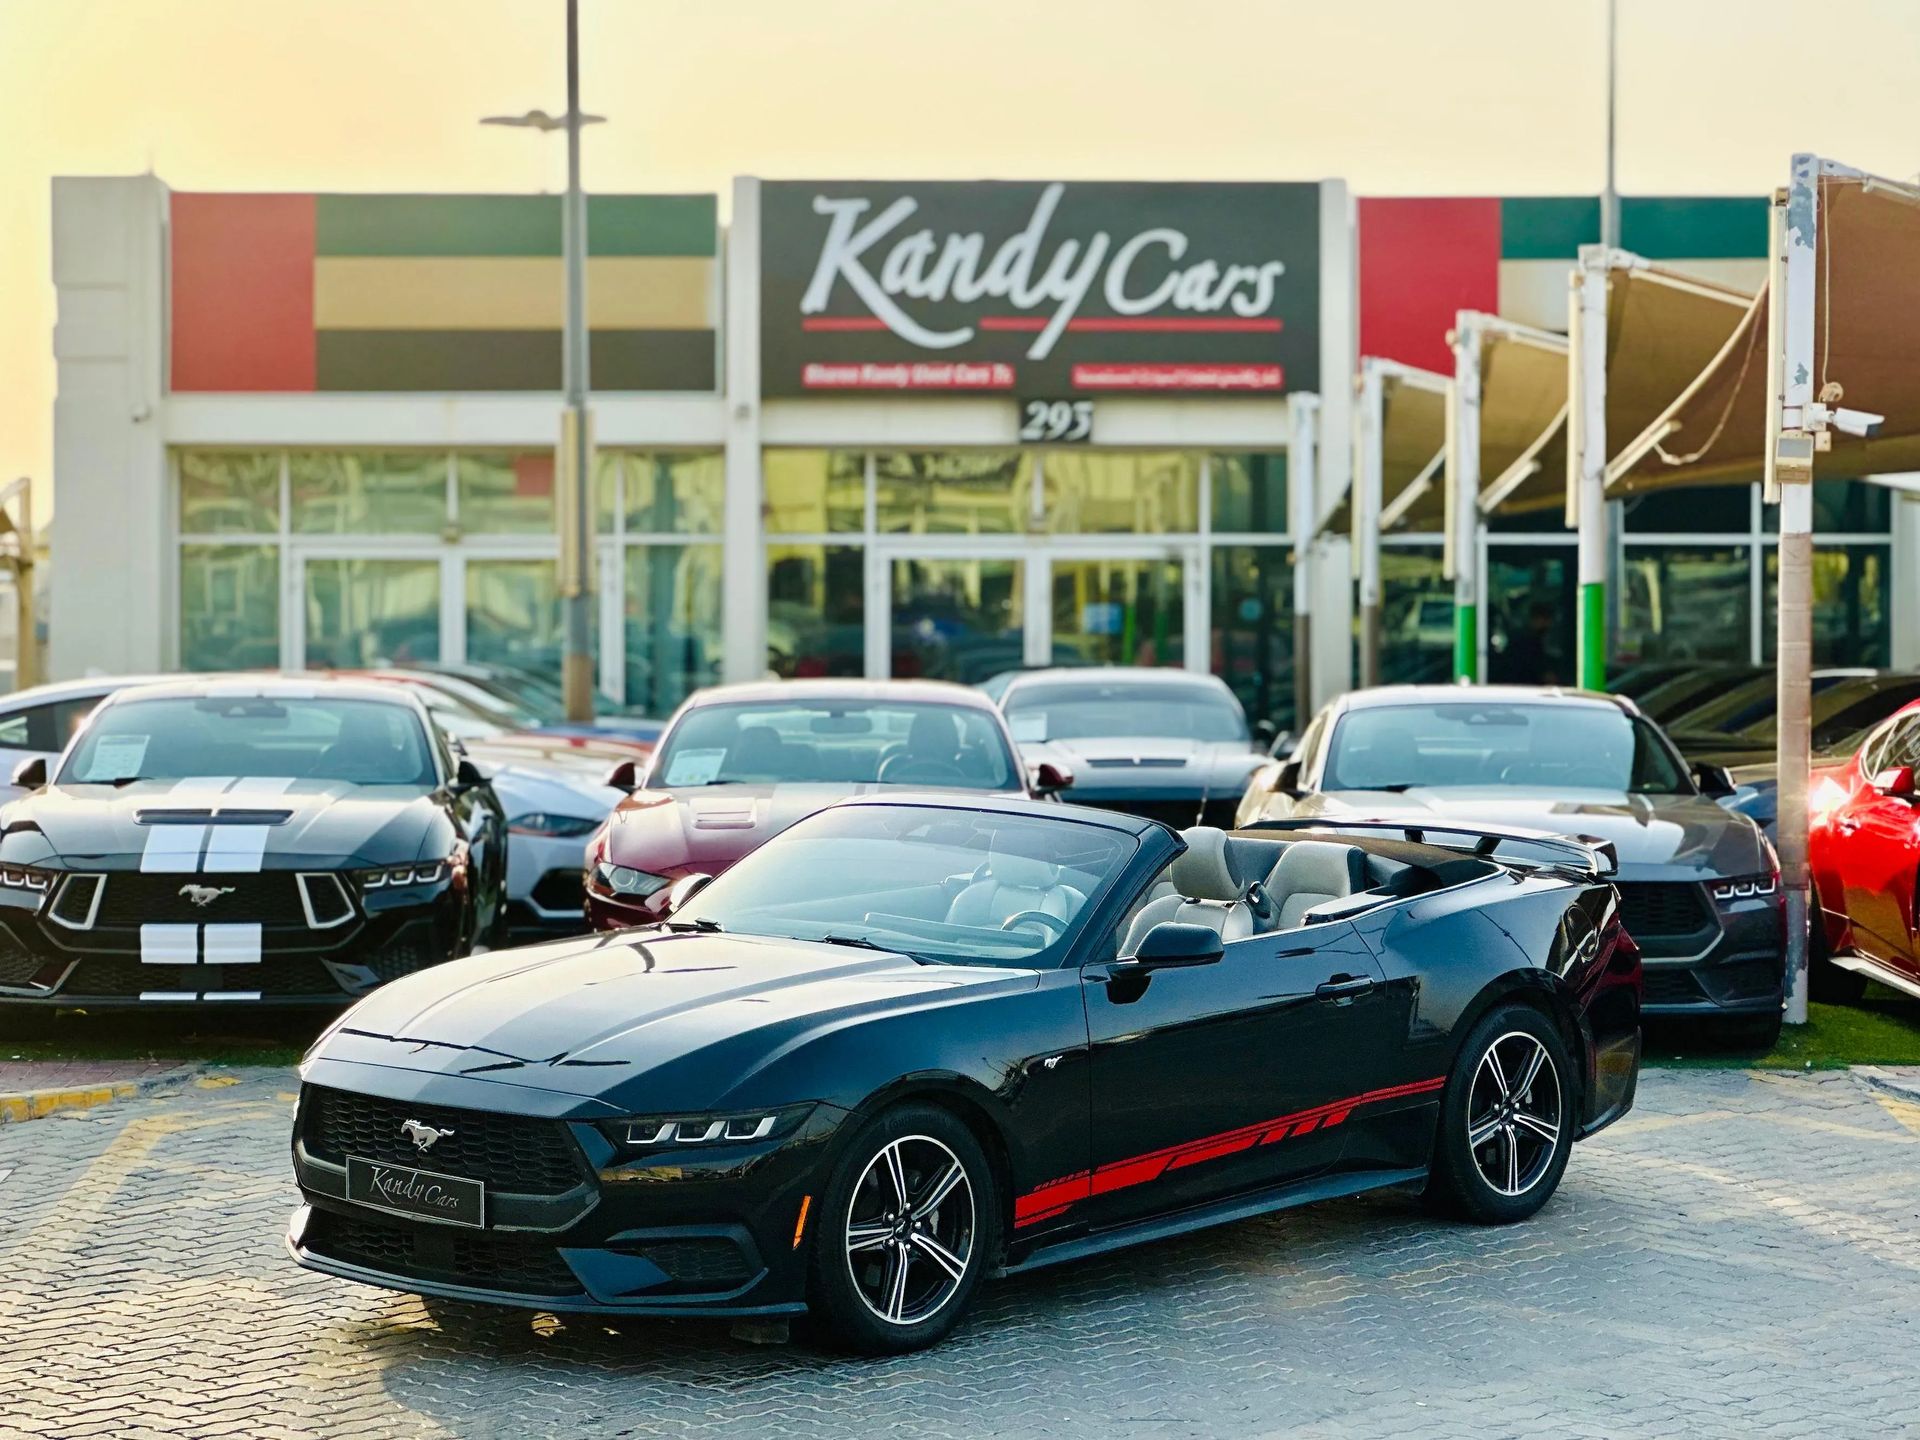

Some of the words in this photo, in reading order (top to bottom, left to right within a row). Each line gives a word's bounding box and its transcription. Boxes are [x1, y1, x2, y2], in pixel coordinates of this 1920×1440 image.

[801, 182, 1110, 359] Kandy
[1104, 229, 1284, 316] Cars
[1020, 400, 1094, 441] 295
[370, 1166, 424, 1206] Kandy
[424, 1185, 459, 1208] Cars
